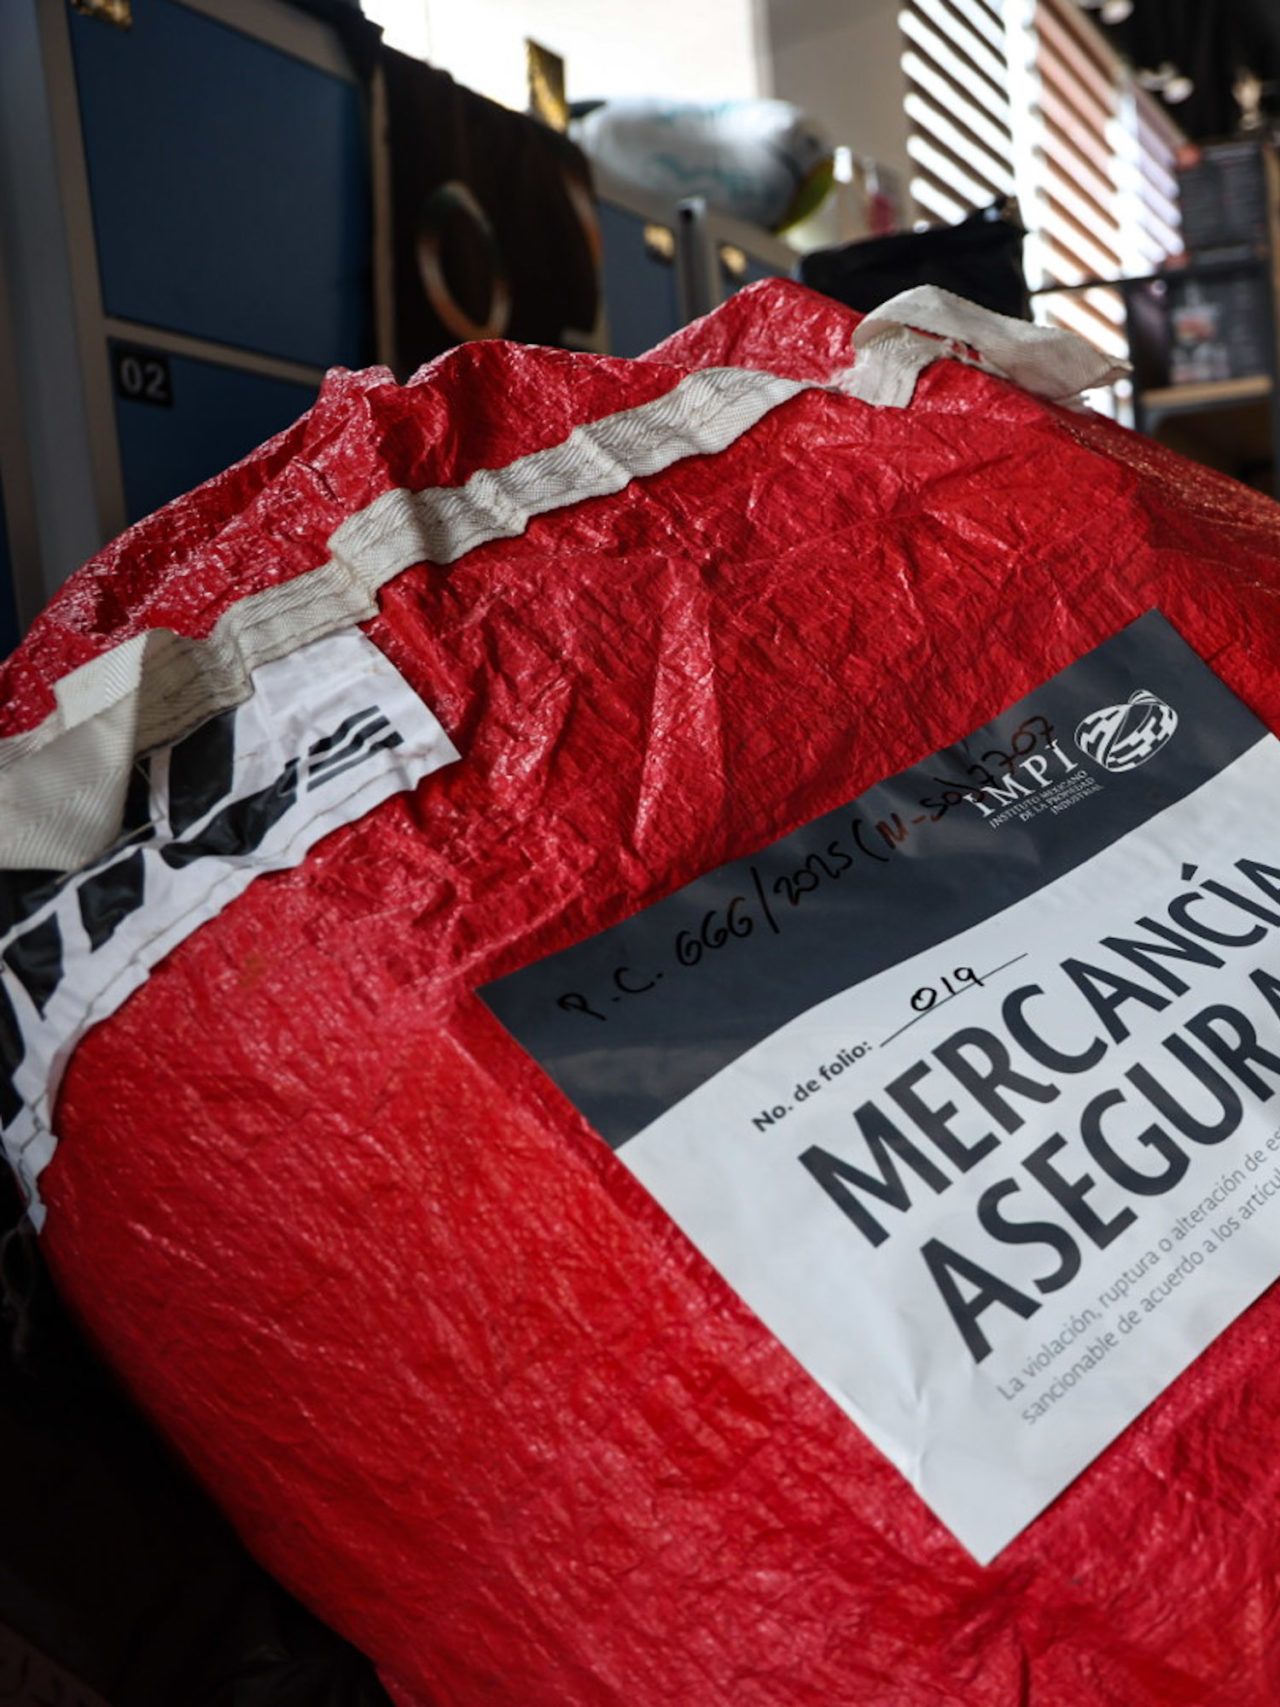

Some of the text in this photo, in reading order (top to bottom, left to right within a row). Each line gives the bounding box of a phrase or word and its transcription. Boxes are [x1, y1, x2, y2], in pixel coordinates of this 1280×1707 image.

[121, 358, 168, 400] 02
[963, 739, 1079, 817] IMPI
[989, 795, 1041, 830] INSTITUTO
[1019, 808, 1036, 823] DE
[1033, 801, 1049, 814] LA
[910, 966, 985, 1012] 019
[751, 1040, 873, 1133] No. de folio:
[996, 1376, 1026, 1402] La
[1022, 1307, 1103, 1379] violación,
[1098, 1250, 1160, 1310] ruptura
[1158, 1237, 1174, 1253] o
[1170, 1167, 1247, 1243] alteración
[1243, 1148, 1269, 1173] de
[1021, 1330, 1120, 1426] sancionable
[1117, 1308, 1144, 1336] de
[1139, 1249, 1205, 1314] acuerdo
[1202, 1238, 1218, 1254] a
[1210, 1214, 1241, 1243] los
